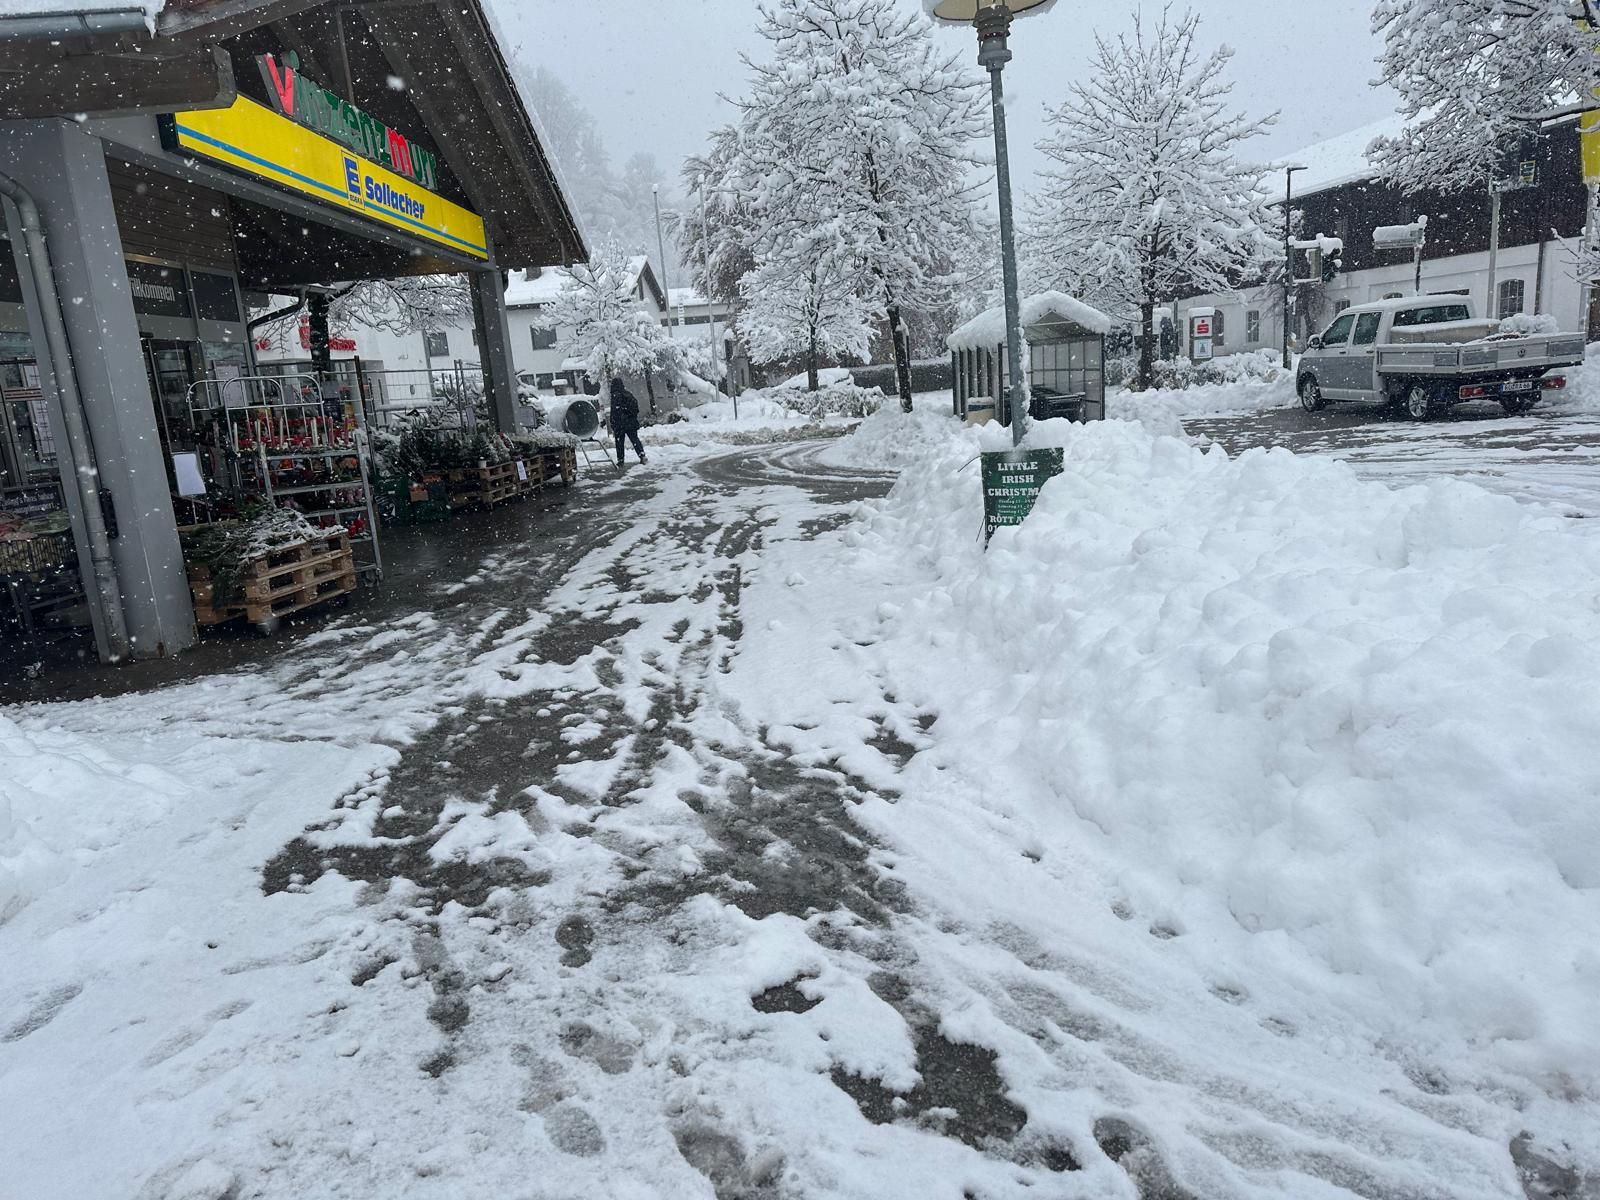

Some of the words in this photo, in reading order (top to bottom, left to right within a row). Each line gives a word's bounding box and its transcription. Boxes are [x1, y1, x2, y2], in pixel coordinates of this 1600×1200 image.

[364, 175, 425, 220] Sollacher
[128, 277, 176, 302] illkommen
[998, 462, 1038, 471] LITTLE
[1002, 475, 1034, 483] IRISH
[988, 488, 1039, 496] CHRISTM
